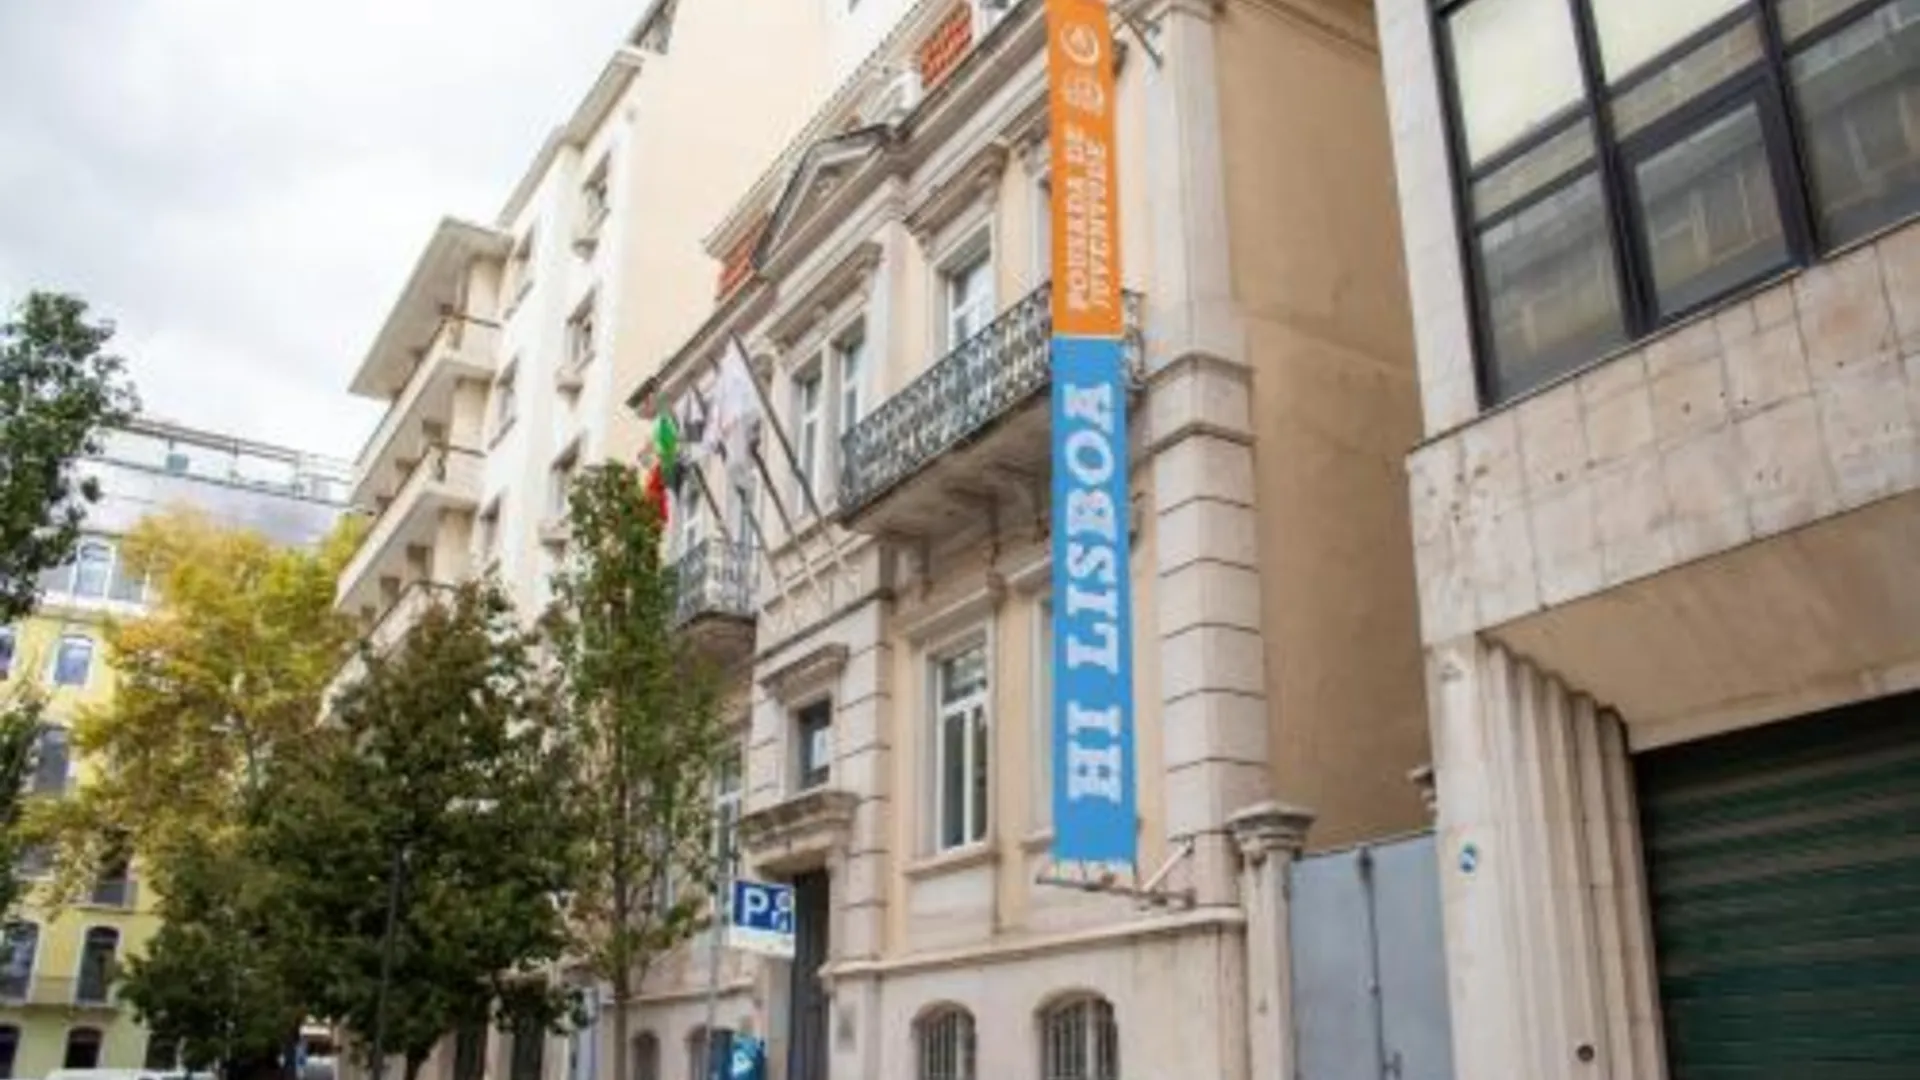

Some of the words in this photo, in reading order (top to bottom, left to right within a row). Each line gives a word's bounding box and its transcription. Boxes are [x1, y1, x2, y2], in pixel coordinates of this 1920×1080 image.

[1064, 383, 1119, 676] LISBOA
[1067, 702, 1122, 803] HI
[744, 886, 769, 925] P
